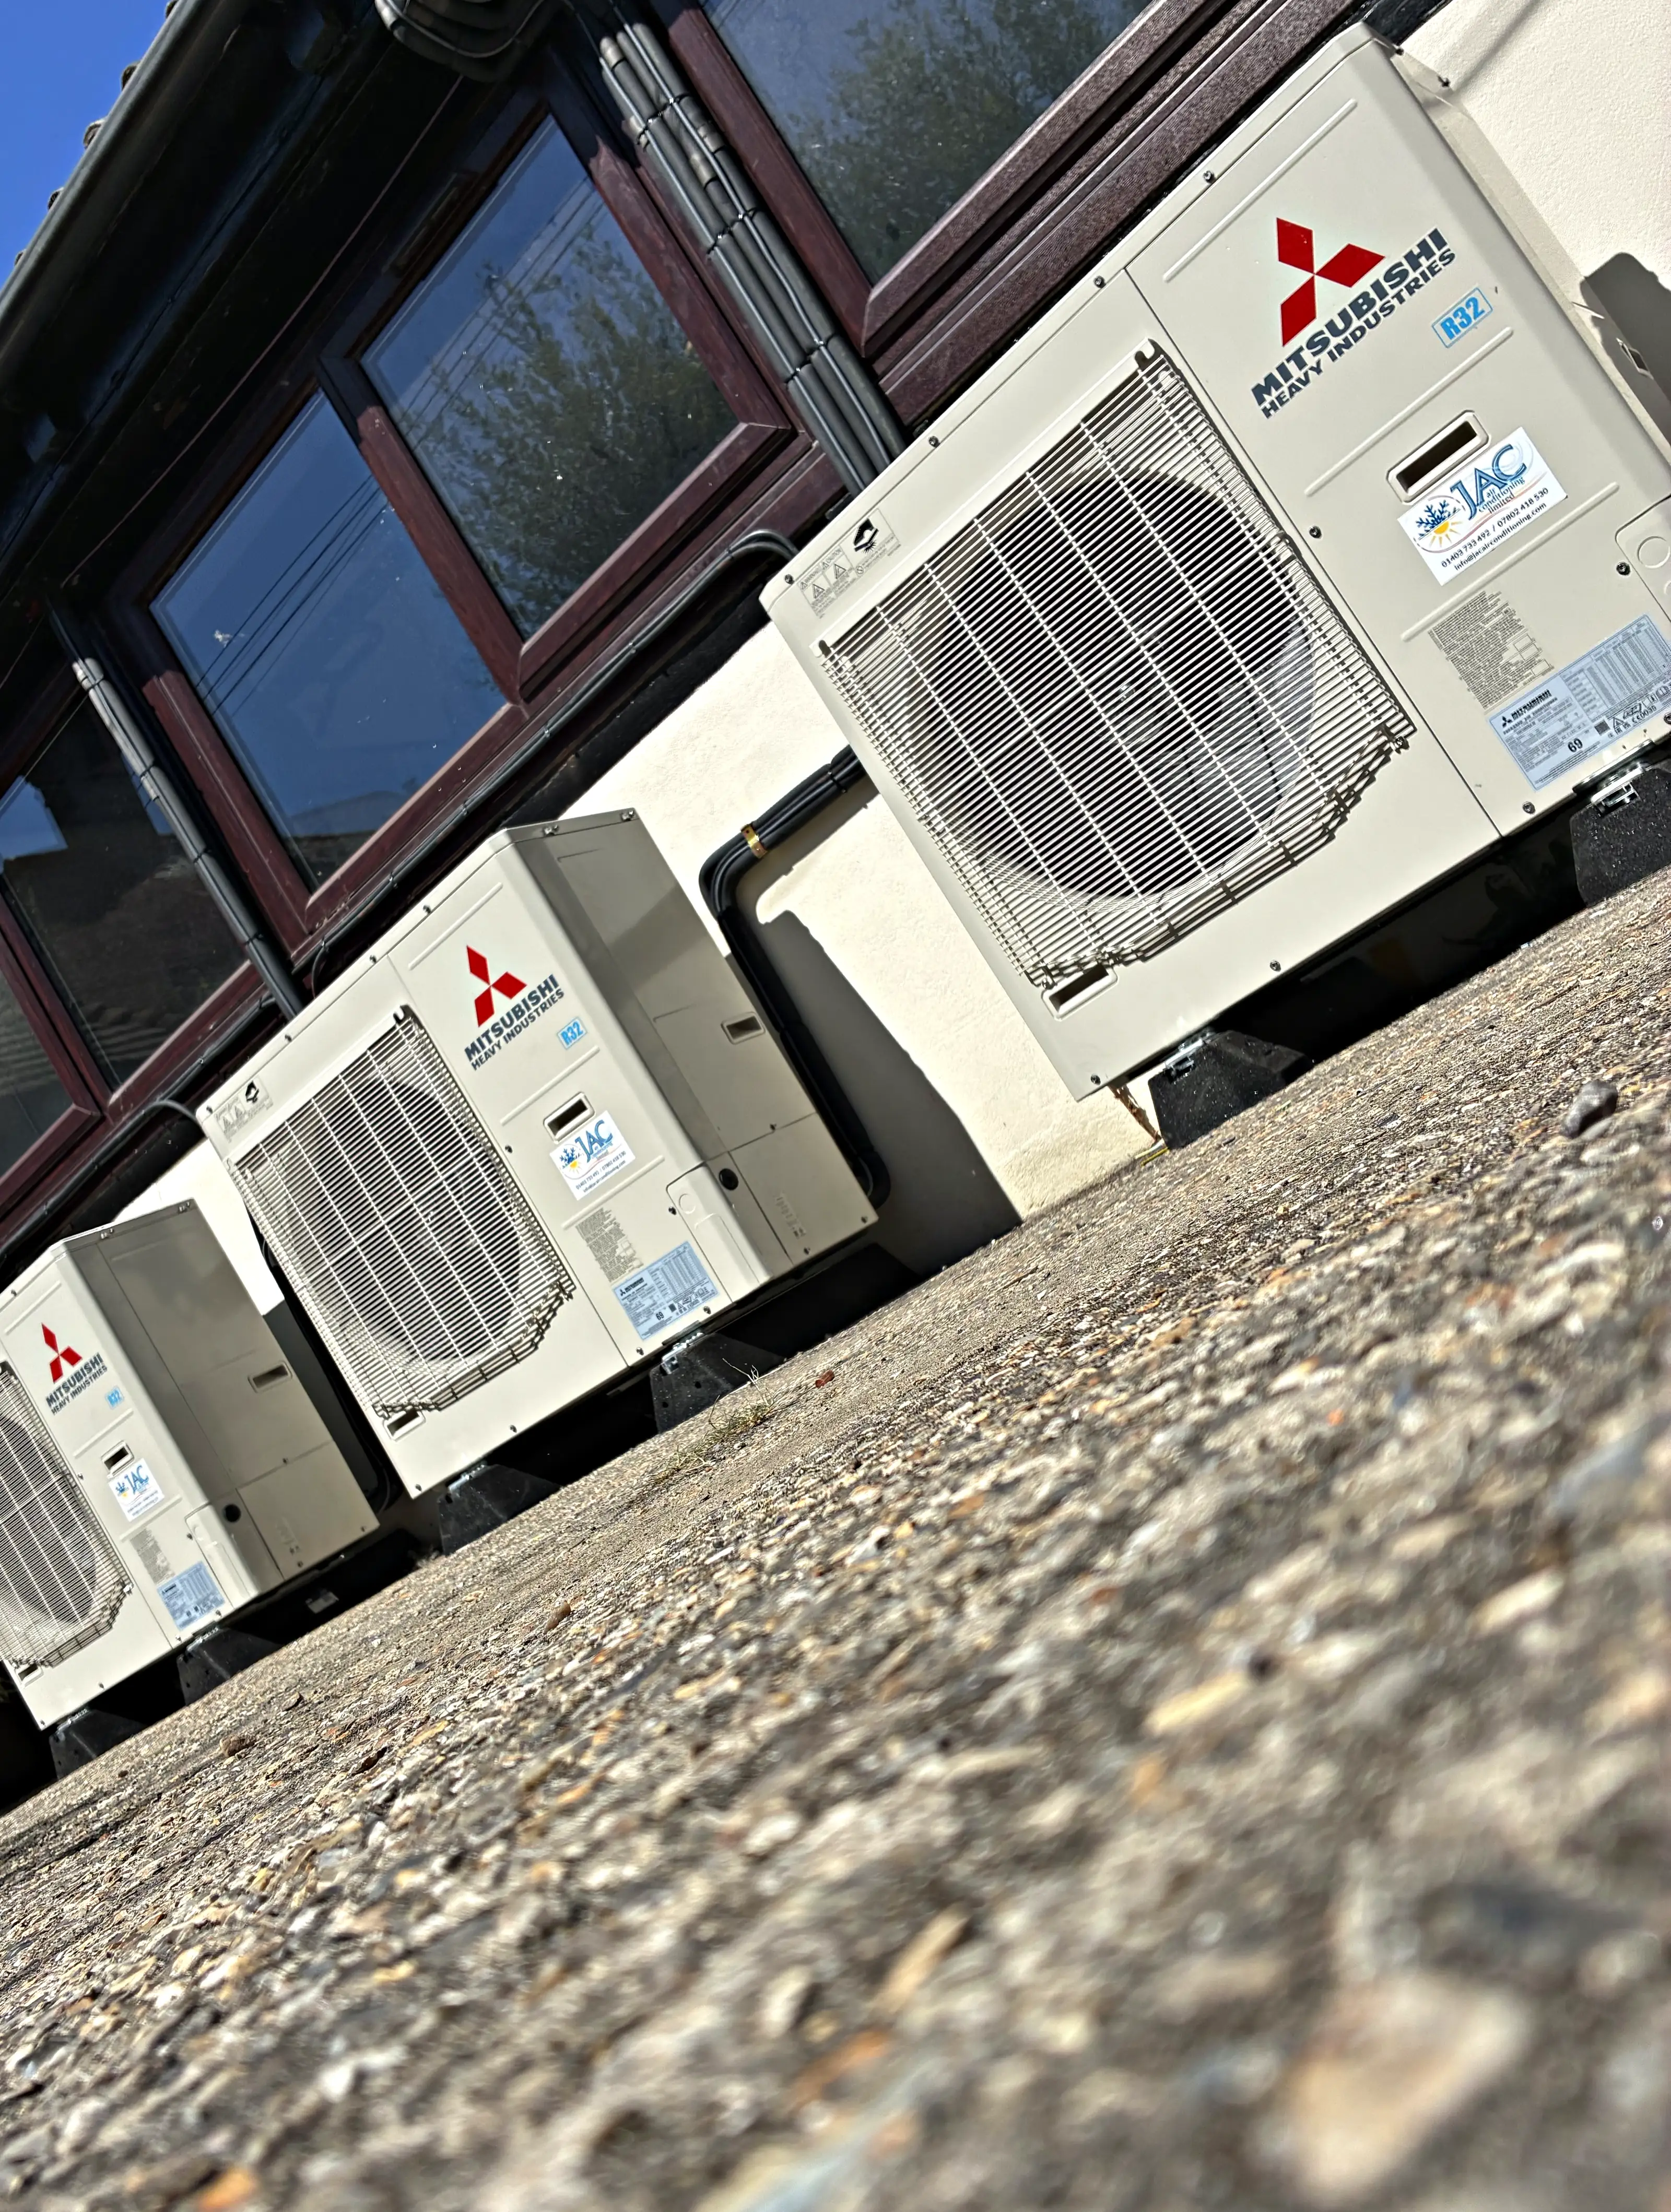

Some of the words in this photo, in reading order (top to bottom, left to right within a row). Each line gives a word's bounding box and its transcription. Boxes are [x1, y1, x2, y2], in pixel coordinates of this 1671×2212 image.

[1251, 228, 1448, 406] MITSUBISHI
[1261, 359, 1323, 419] HEAVY
[1326, 248, 1456, 363] INDUSTRIES
[1440, 296, 1485, 340] R32
[1450, 444, 1527, 521] JAC
[1478, 477, 1525, 513] conditioning
[1489, 492, 1515, 514] limited
[1454, 502, 1547, 571] info@jacairconditioning.com
[1568, 737, 1583, 753] 69
[464, 974, 559, 1062] MITSUBISHI
[471, 1039, 502, 1071] HEAVY
[503, 988, 564, 1044] INDUSTRIES
[560, 1021, 584, 1046] R32
[574, 1119, 613, 1163] JAC
[656, 1311, 665, 1321] 69
[45, 1352, 104, 1408] MITSUBISHI
[51, 1395, 70, 1416] HEAVY
[70, 1365, 108, 1400] INDUSTRIES
[124, 1464, 149, 1495] JAC
